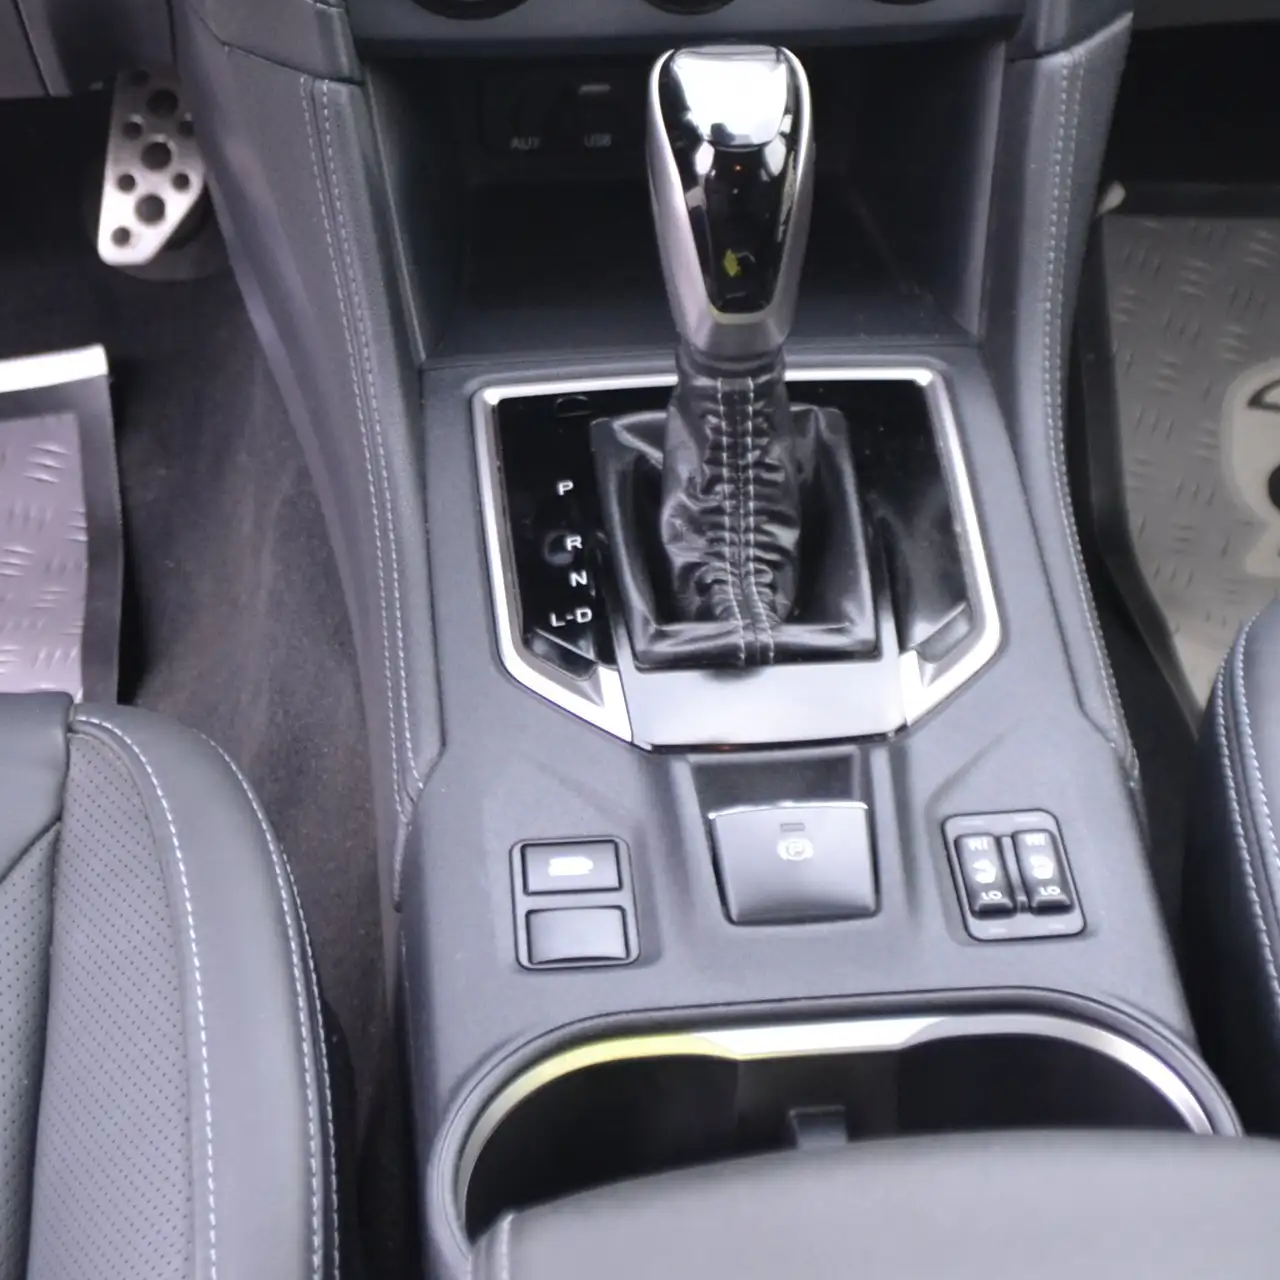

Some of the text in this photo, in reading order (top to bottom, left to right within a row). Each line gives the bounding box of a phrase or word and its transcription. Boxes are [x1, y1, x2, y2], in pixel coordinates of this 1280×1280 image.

[557, 480, 574, 496] P
[566, 535, 583, 551] R
[570, 570, 588, 588] N
[981, 890, 1003, 901] LO
[1039, 885, 1062, 897] LO
